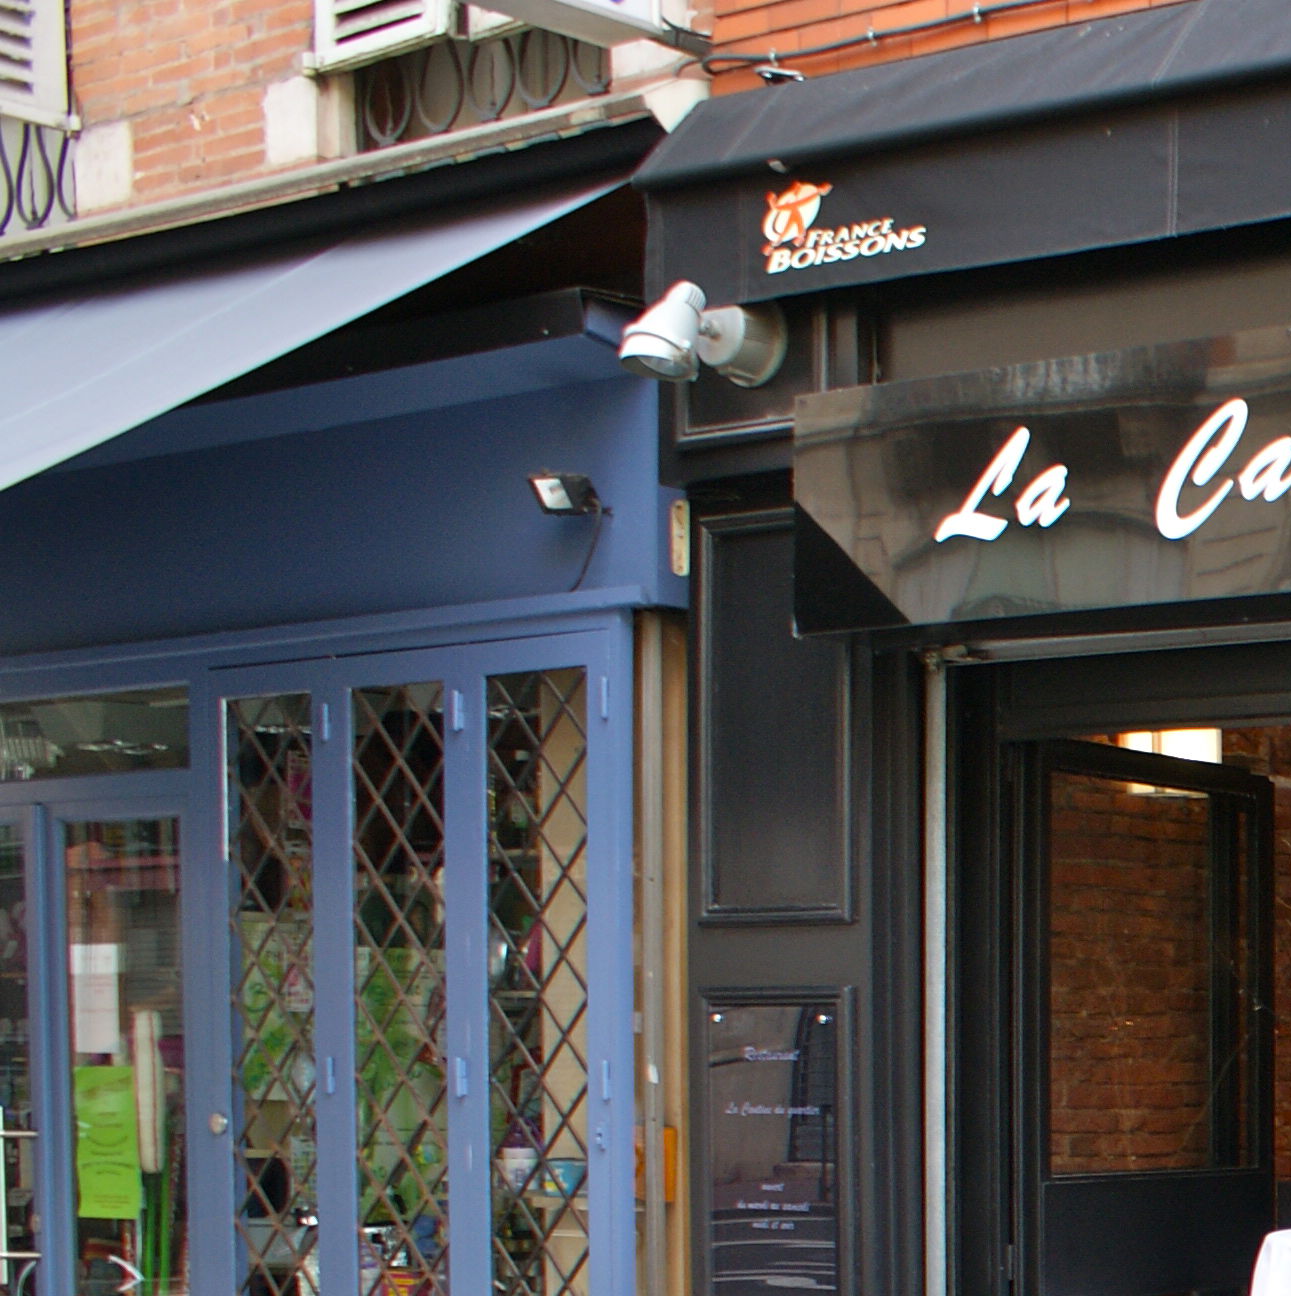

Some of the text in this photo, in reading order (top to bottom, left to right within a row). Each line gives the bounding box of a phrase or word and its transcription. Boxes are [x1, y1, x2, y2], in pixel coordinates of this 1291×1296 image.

[765, 224, 927, 275] BOISSONS
[805, 217, 895, 249] FRANCE
[934, 425, 1071, 542] La
